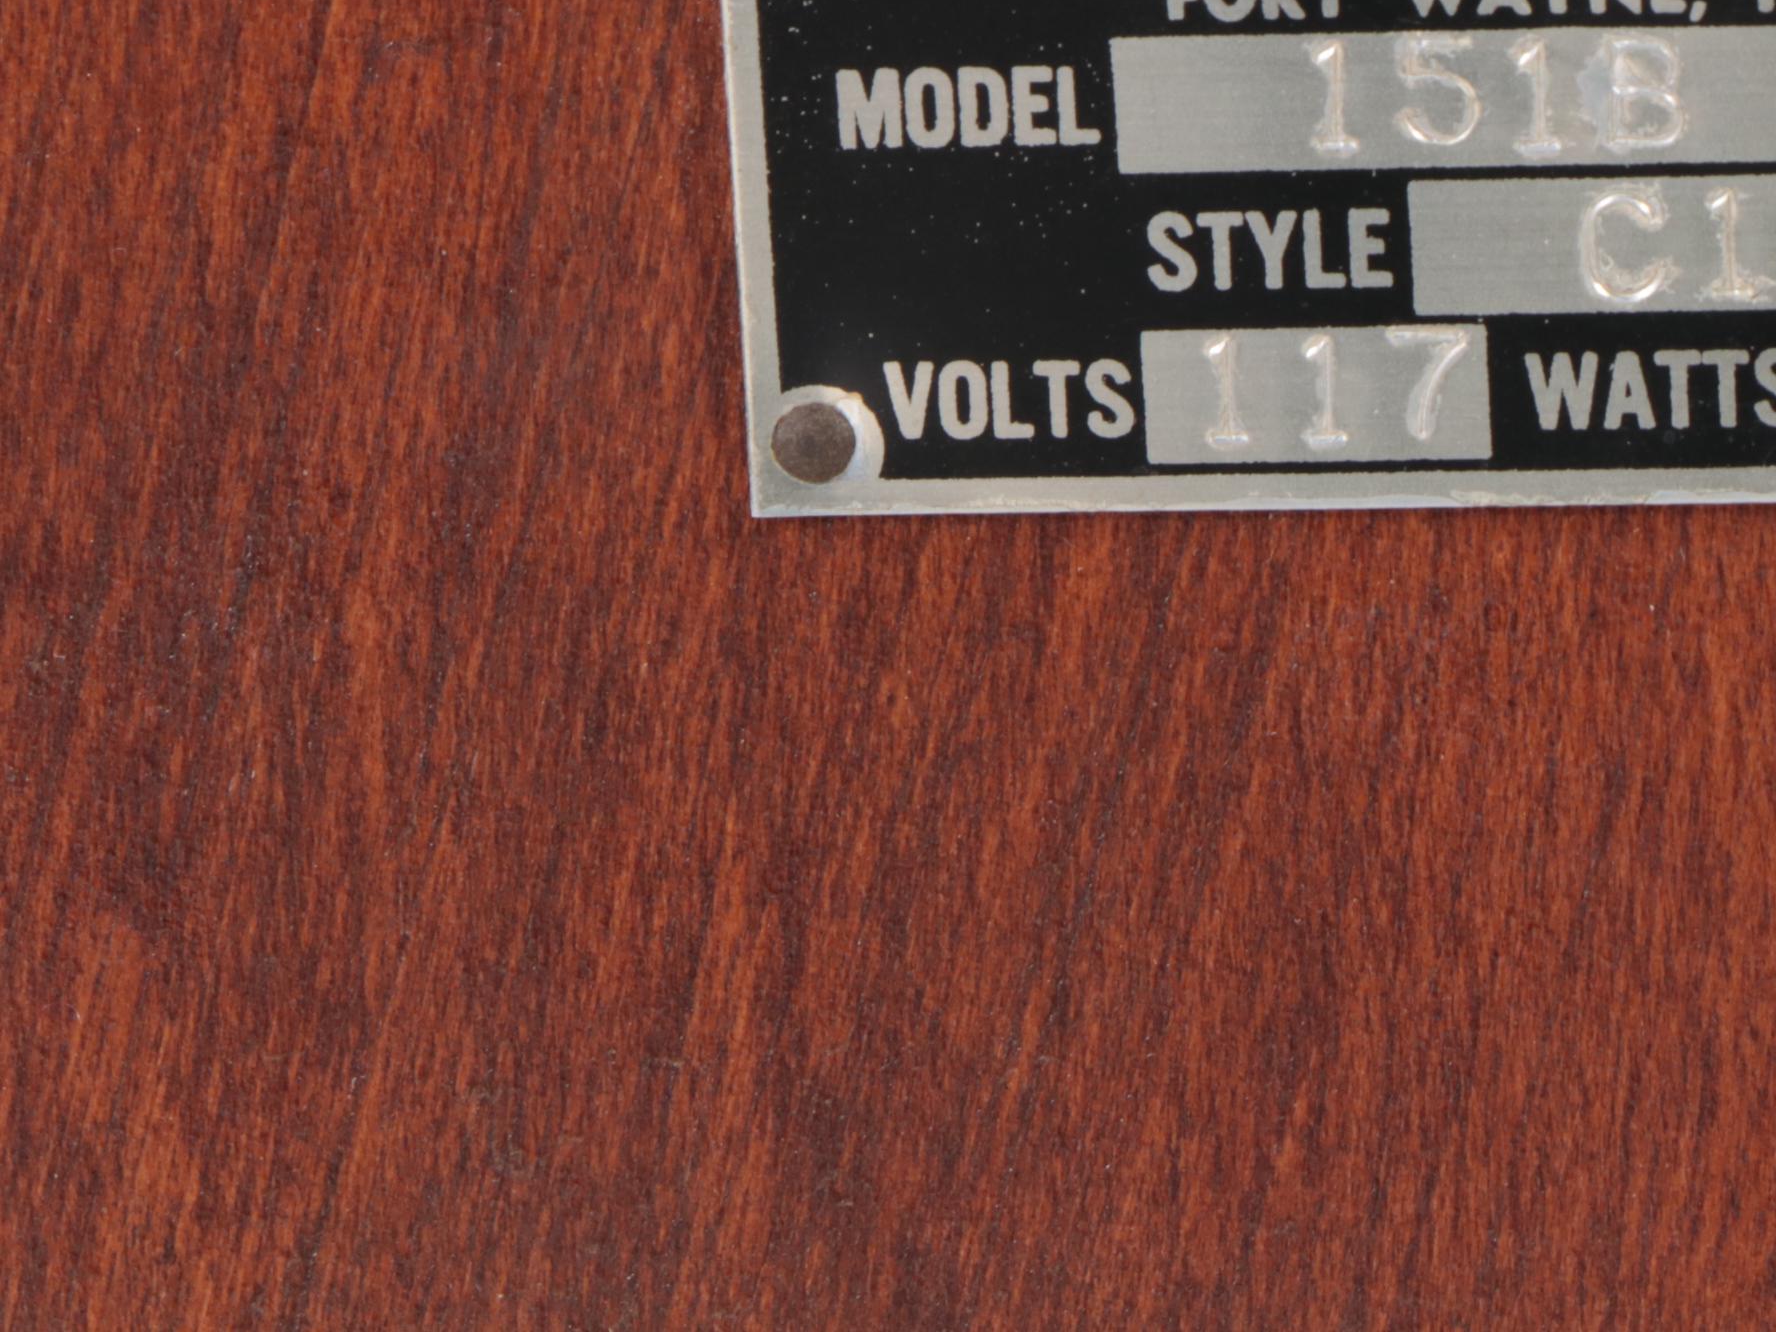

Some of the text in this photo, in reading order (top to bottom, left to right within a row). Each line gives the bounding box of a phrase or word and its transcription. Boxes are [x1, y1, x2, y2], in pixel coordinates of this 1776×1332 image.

[834, 30, 1690, 158] MODEL 151B
[1146, 208, 1394, 293] STYLE
[883, 324, 1470, 453] VOLTS 117
